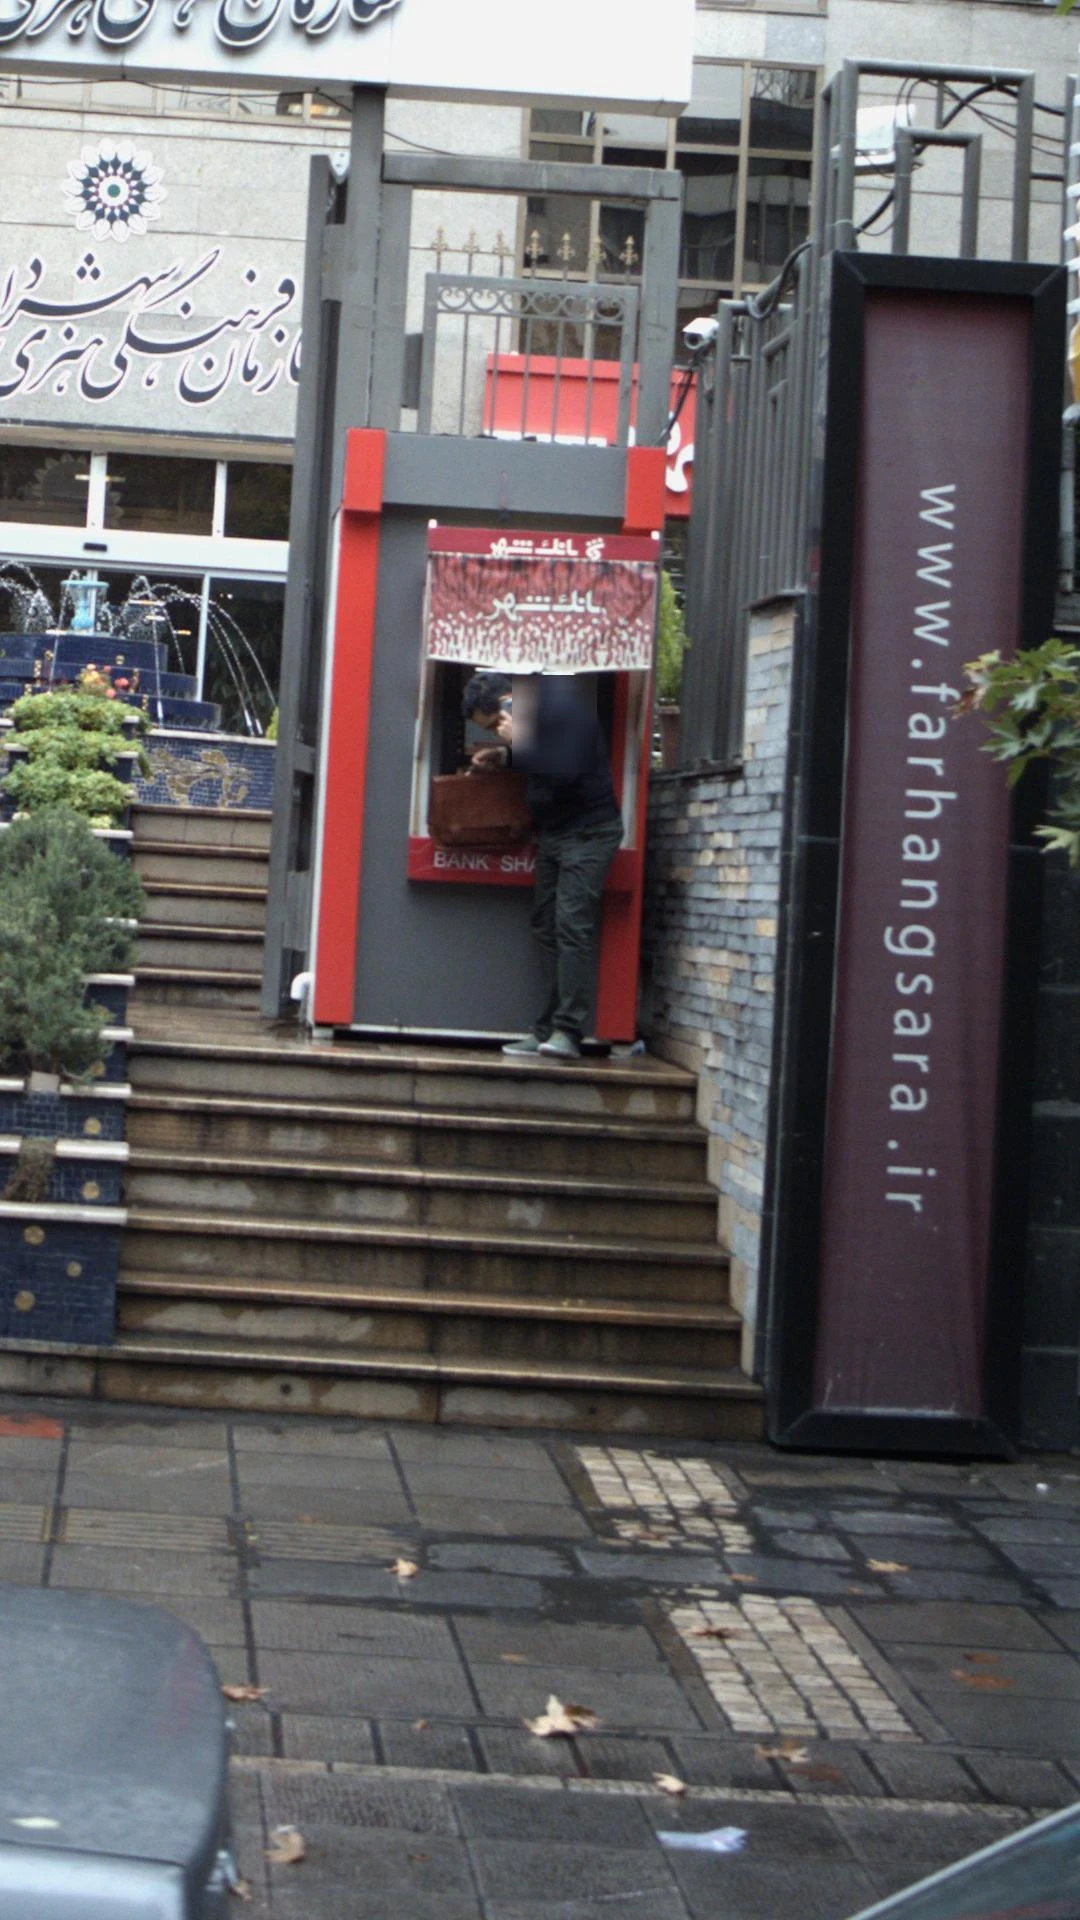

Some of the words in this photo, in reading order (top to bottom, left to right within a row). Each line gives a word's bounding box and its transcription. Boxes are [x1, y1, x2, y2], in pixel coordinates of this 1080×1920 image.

[489, 537, 534, 560] شهر
[475, 591, 551, 621] شهر
[551, 589, 607, 616] بانک
[433, 850, 490, 871] BANK
[500, 854, 537, 873] SHA
[884, 483, 957, 1214] www.farhangsara.ir
